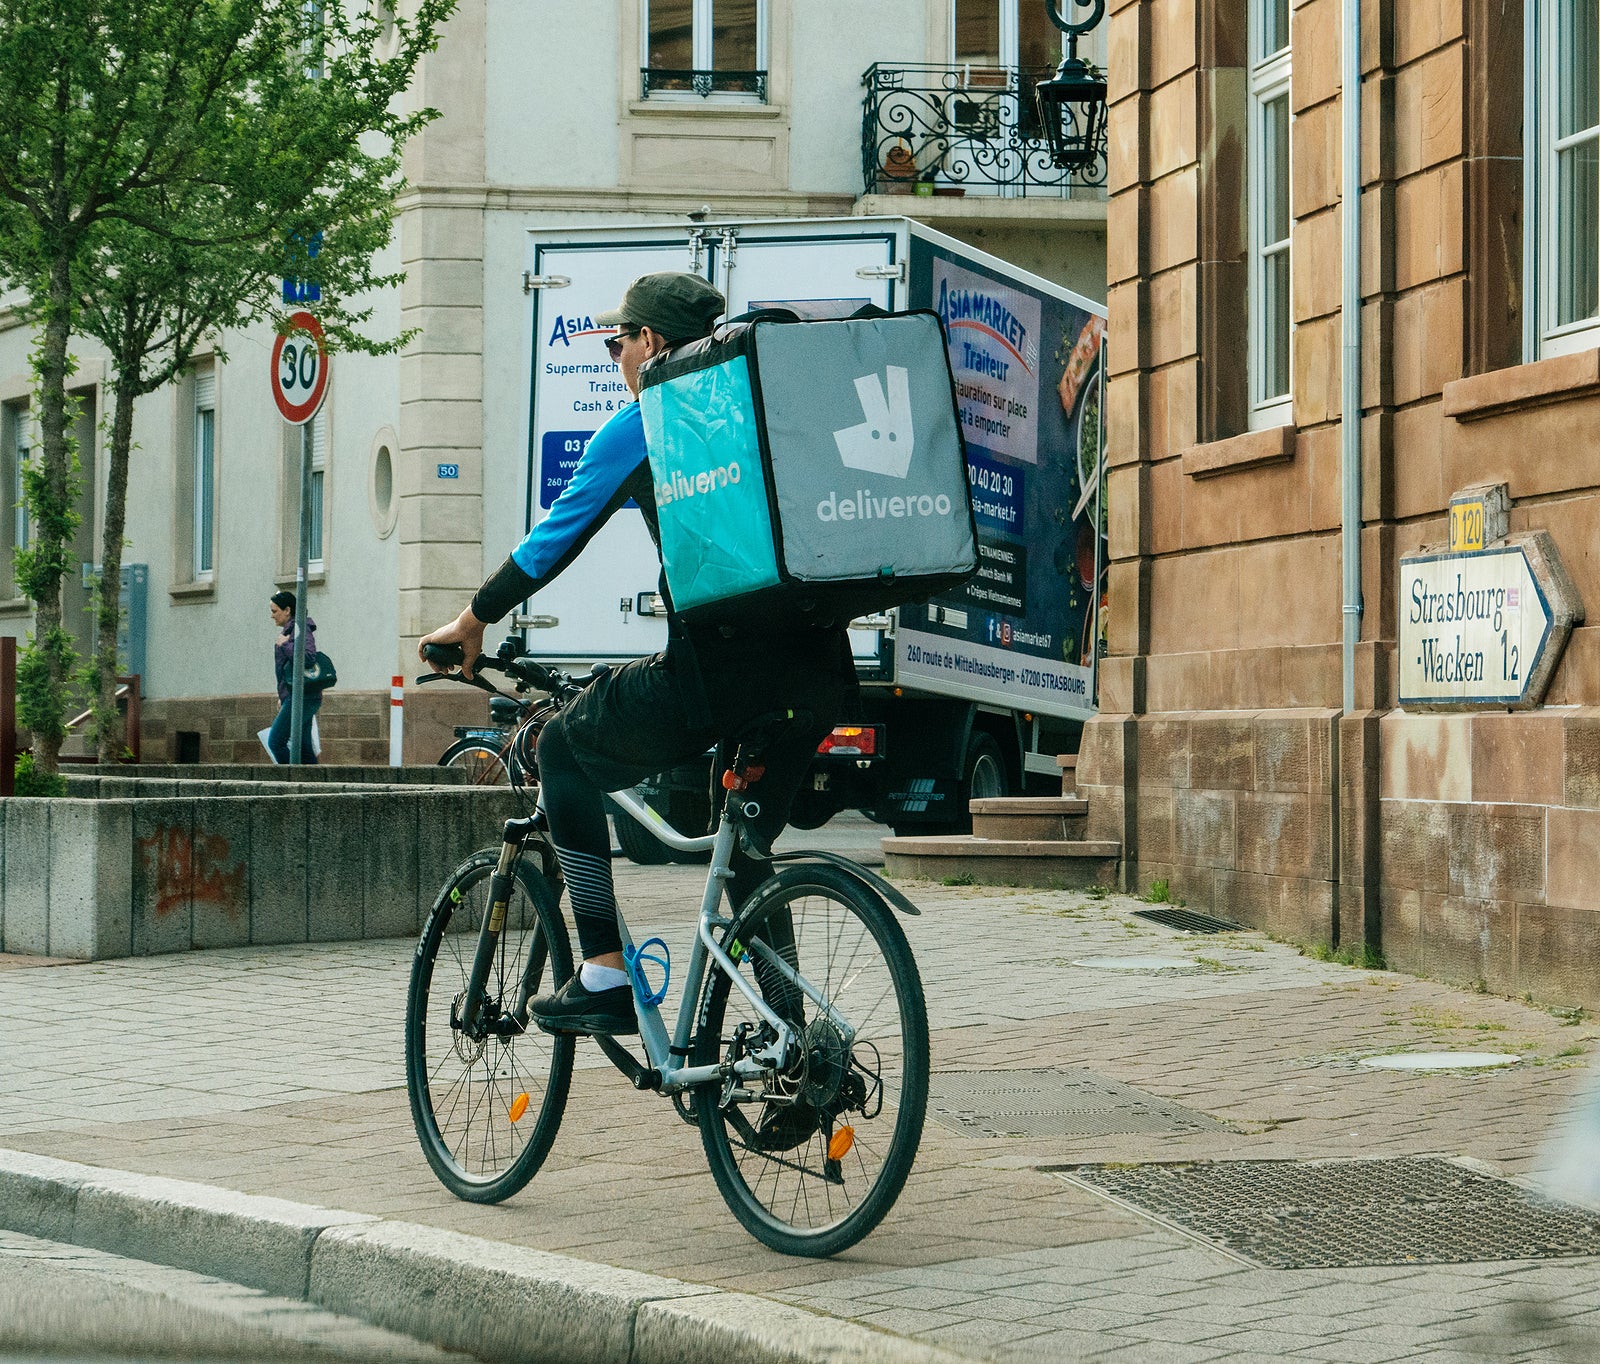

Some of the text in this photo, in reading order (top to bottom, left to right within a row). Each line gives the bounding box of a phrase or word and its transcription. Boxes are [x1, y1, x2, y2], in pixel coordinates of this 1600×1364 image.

[549, 315, 594, 347] ASIA
[938, 278, 1026, 352] ASIA MARKET
[281, 344, 316, 389] 30
[546, 362, 619, 376] Supermarch
[963, 342, 1009, 382] Traiteur
[573, 400, 602, 411] Cash
[606, 400, 614, 411] &
[956, 379, 1028, 418] tauration sur place
[968, 407, 974, 426] à
[975, 415, 1011, 438] emporter
[564, 439, 581, 452] 03
[440, 466, 456, 476] 50
[547, 477, 562, 486] 260
[978, 468, 989, 490] 40
[990, 471, 1001, 493] 20
[1002, 475, 1013, 497] 30
[817, 490, 951, 522] deliveroo
[1452, 509, 1480, 546] D 120
[1410, 574, 1506, 632] Strasbourg
[907, 644, 921, 663] 260
[922, 651, 942, 667] route
[944, 652, 953, 669] de
[954, 654, 1015, 685] Mittelhausbergen
[1021, 668, 1040, 687] 67200
[1041, 672, 1086, 695] STRASBOURG
